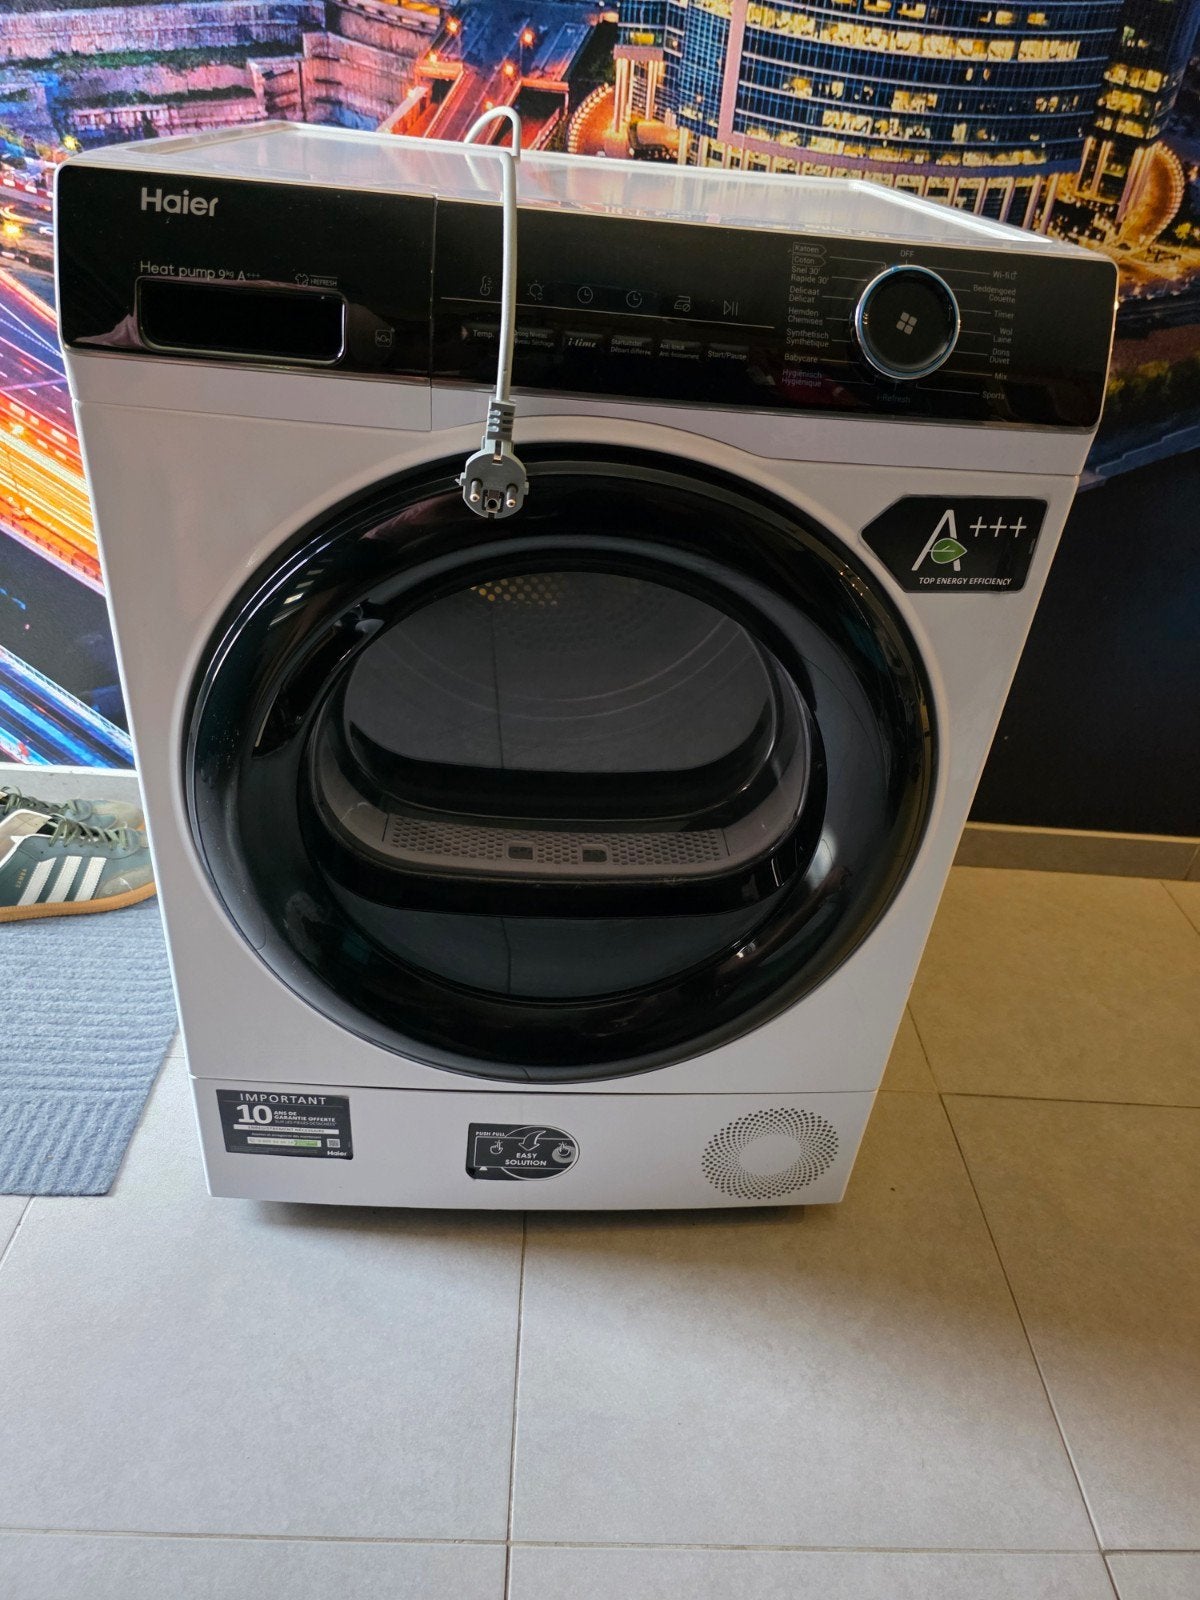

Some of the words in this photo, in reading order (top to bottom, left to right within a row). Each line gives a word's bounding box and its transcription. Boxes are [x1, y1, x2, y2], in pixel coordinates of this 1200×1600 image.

[141, 187, 219, 217] Haier
[794, 245, 820, 254] Katoen
[900, 250, 915, 258] OFF
[794, 256, 815, 265] Coton
[140, 261, 175, 276] Heat
[178, 267, 215, 282] pump
[791, 266, 808, 274] Snel
[791, 274, 816, 284] Rapide
[789, 286, 820, 296] Delicaat
[973, 284, 1016, 297] Beddengoed
[788, 307, 819, 317] Hemden
[994, 310, 1015, 320] Timer
[787, 315, 824, 326] Chemises
[472, 329, 495, 339] Temp.
[786, 328, 830, 339] Synthetisch
[999, 327, 1013, 335] Wol
[707, 350, 747, 361] Start/Pause
[784, 353, 818, 363] Babycare
[994, 372, 1008, 380] Mix
[919, 577, 935, 585] TOP
[936, 577, 968, 585] ENERGY
[969, 577, 1012, 586] EFFICIENCY
[240, 1093, 326, 1105] IMPORTANT
[236, 1104, 273, 1124] 10
